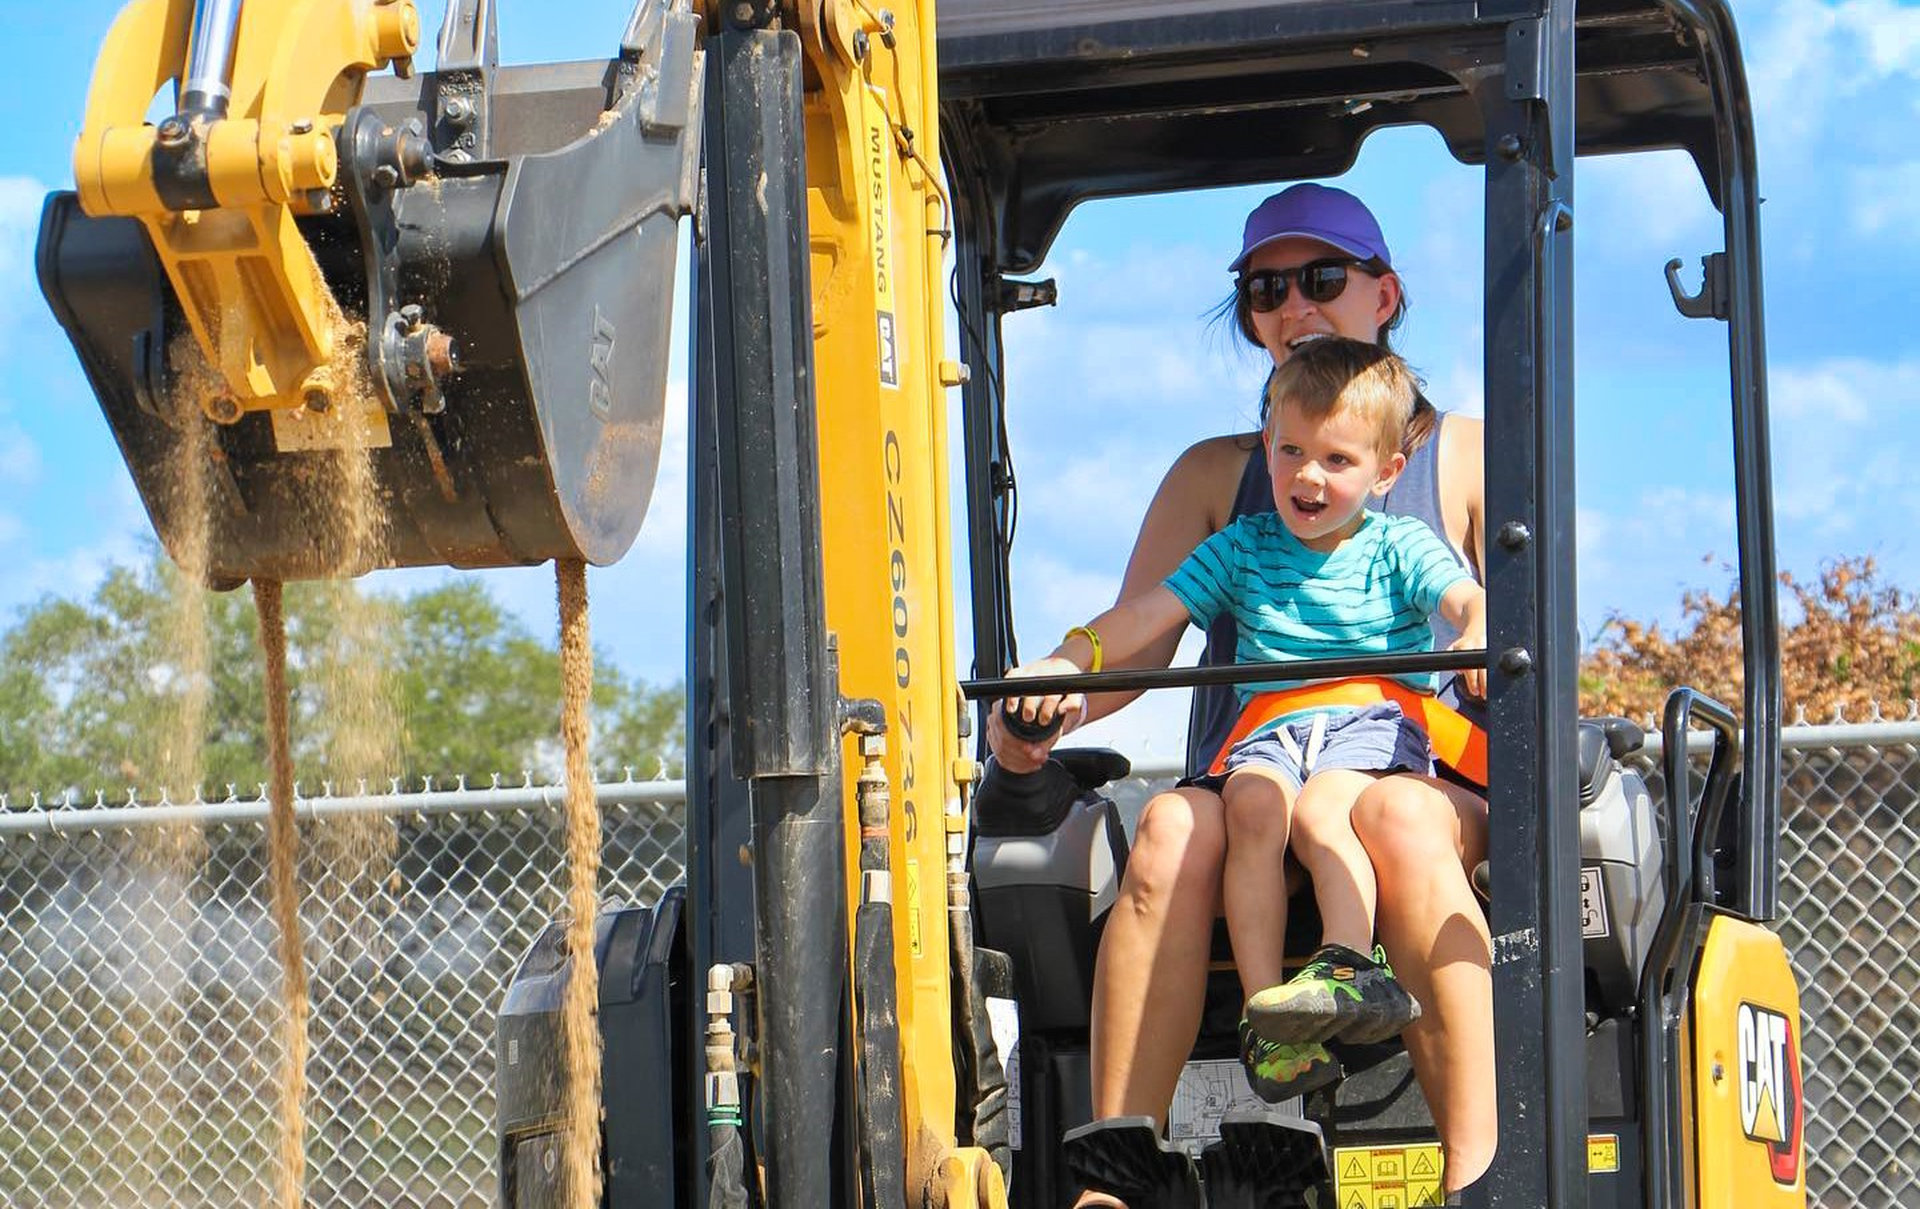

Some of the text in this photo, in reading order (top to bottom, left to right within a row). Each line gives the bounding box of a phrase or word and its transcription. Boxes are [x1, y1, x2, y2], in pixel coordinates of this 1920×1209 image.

[871, 126, 887, 294] MUSTANG
[589, 303, 616, 414] CAT
[878, 315, 895, 382] CAT
[885, 430, 917, 842] CZ600736
[1738, 1003, 1787, 1142] CAT
